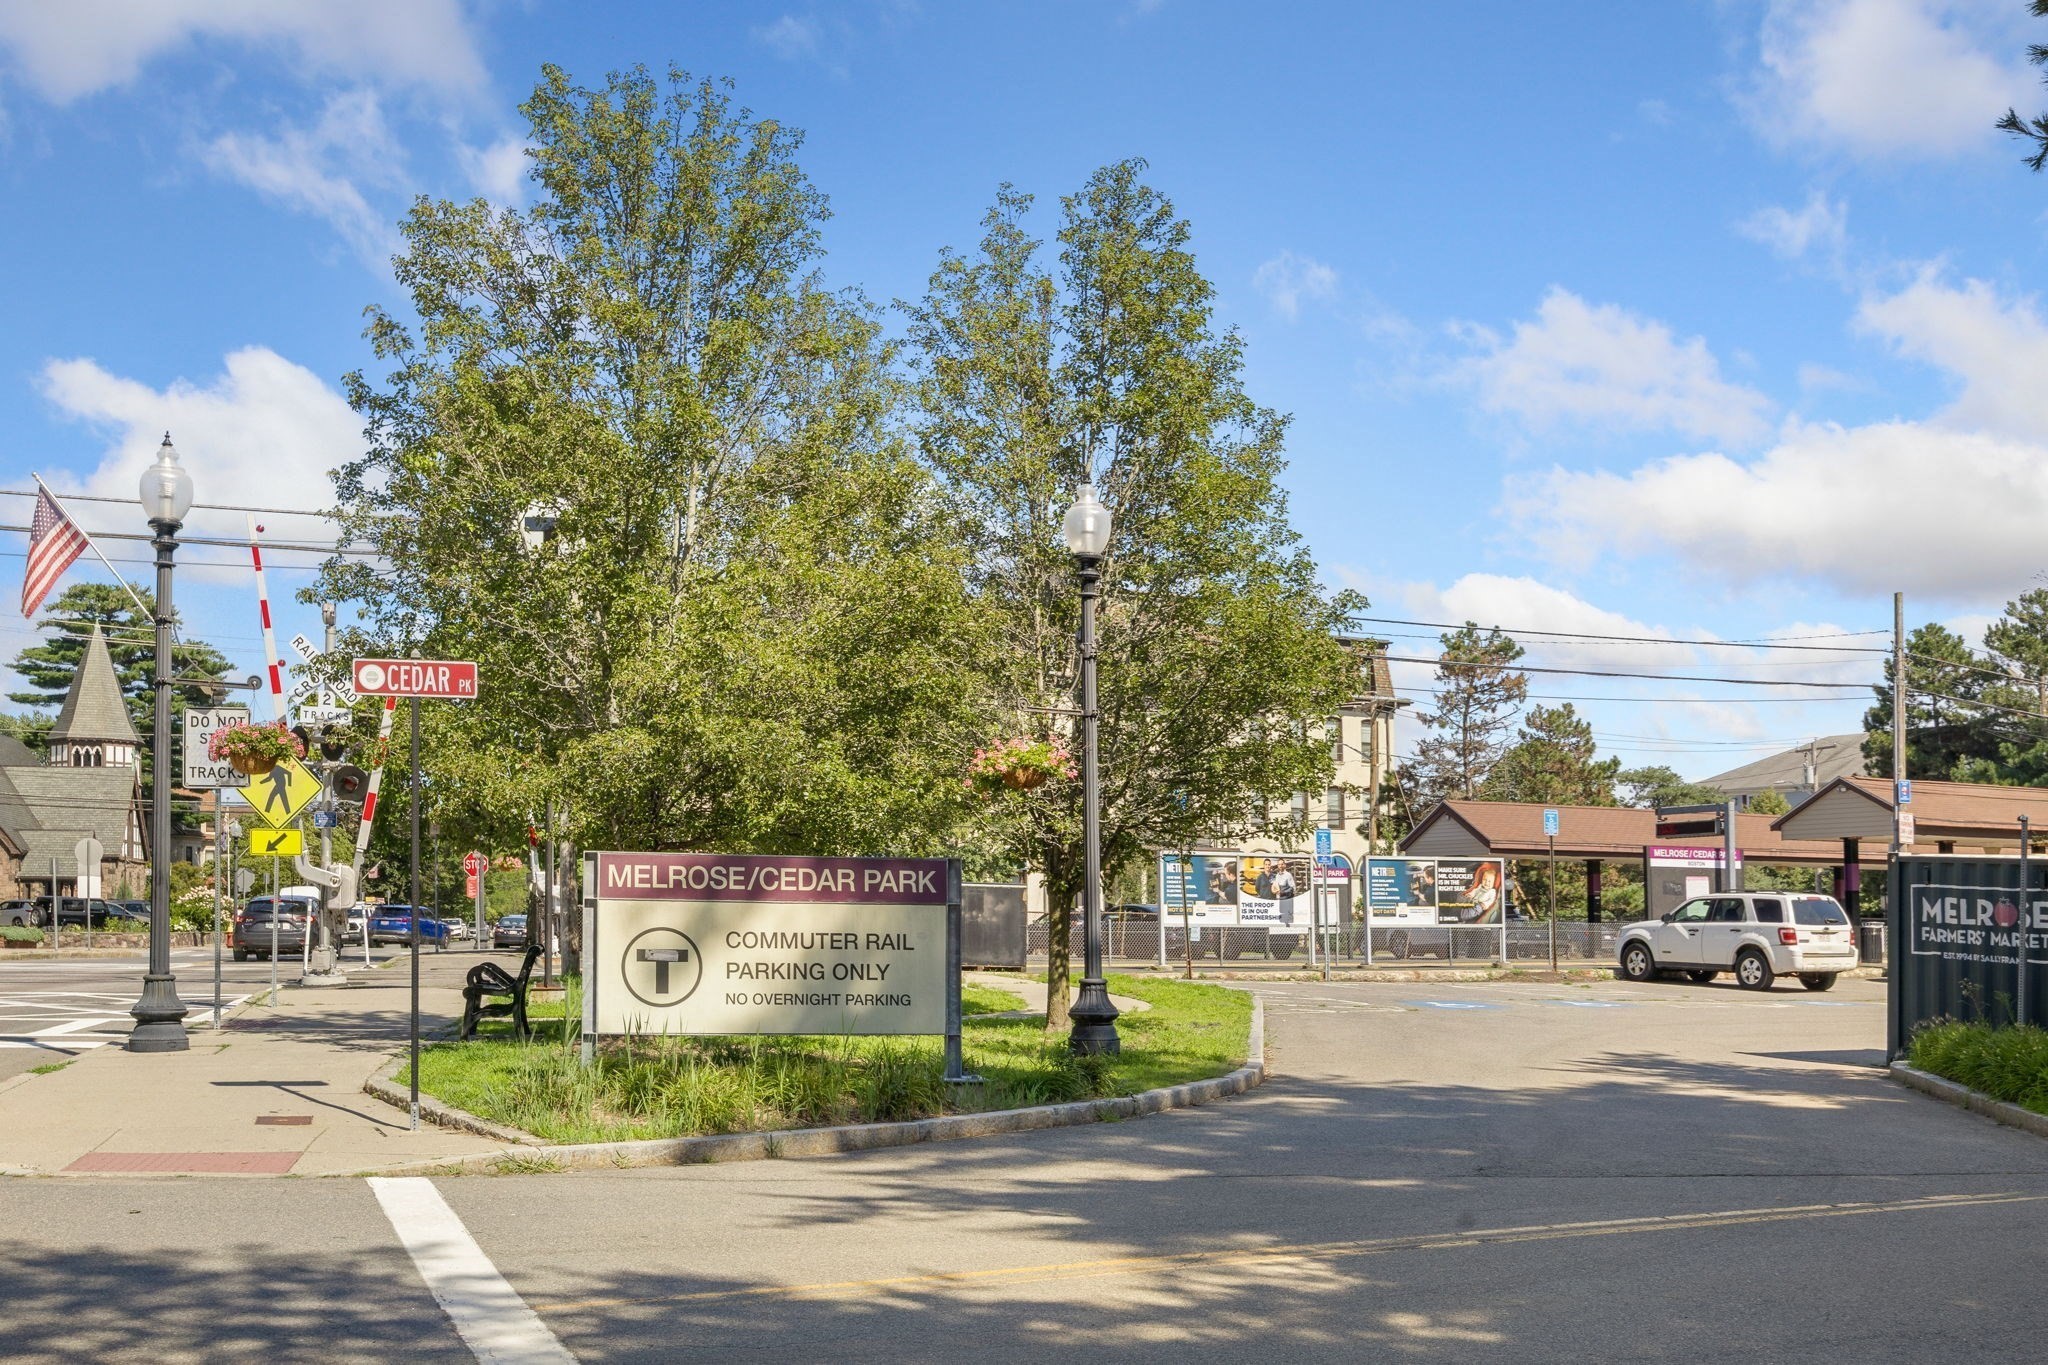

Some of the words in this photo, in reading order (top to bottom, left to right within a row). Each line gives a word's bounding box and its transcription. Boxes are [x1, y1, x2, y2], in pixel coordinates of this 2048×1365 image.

[387, 664, 450, 693] CEDAR
[458, 679, 472, 693] PK
[322, 692, 331, 705] 2
[190, 716, 210, 728] DO
[217, 716, 246, 728] NOT
[303, 711, 350, 720] TRACKS
[1653, 849, 1689, 858] MELROSE
[608, 864, 856, 892] MELROSE/CEDAR
[864, 869, 937, 893] PARK
[725, 931, 859, 950] COMMUTER
[866, 933, 915, 951] RAIL
[1921, 926, 1986, 946] FARMERS'
[726, 962, 825, 980] PARKING
[832, 963, 890, 981] ONLY
[725, 993, 748, 1005] NO
[752, 993, 841, 1006] OVERNIGHT
[845, 994, 911, 1006] PARKING
